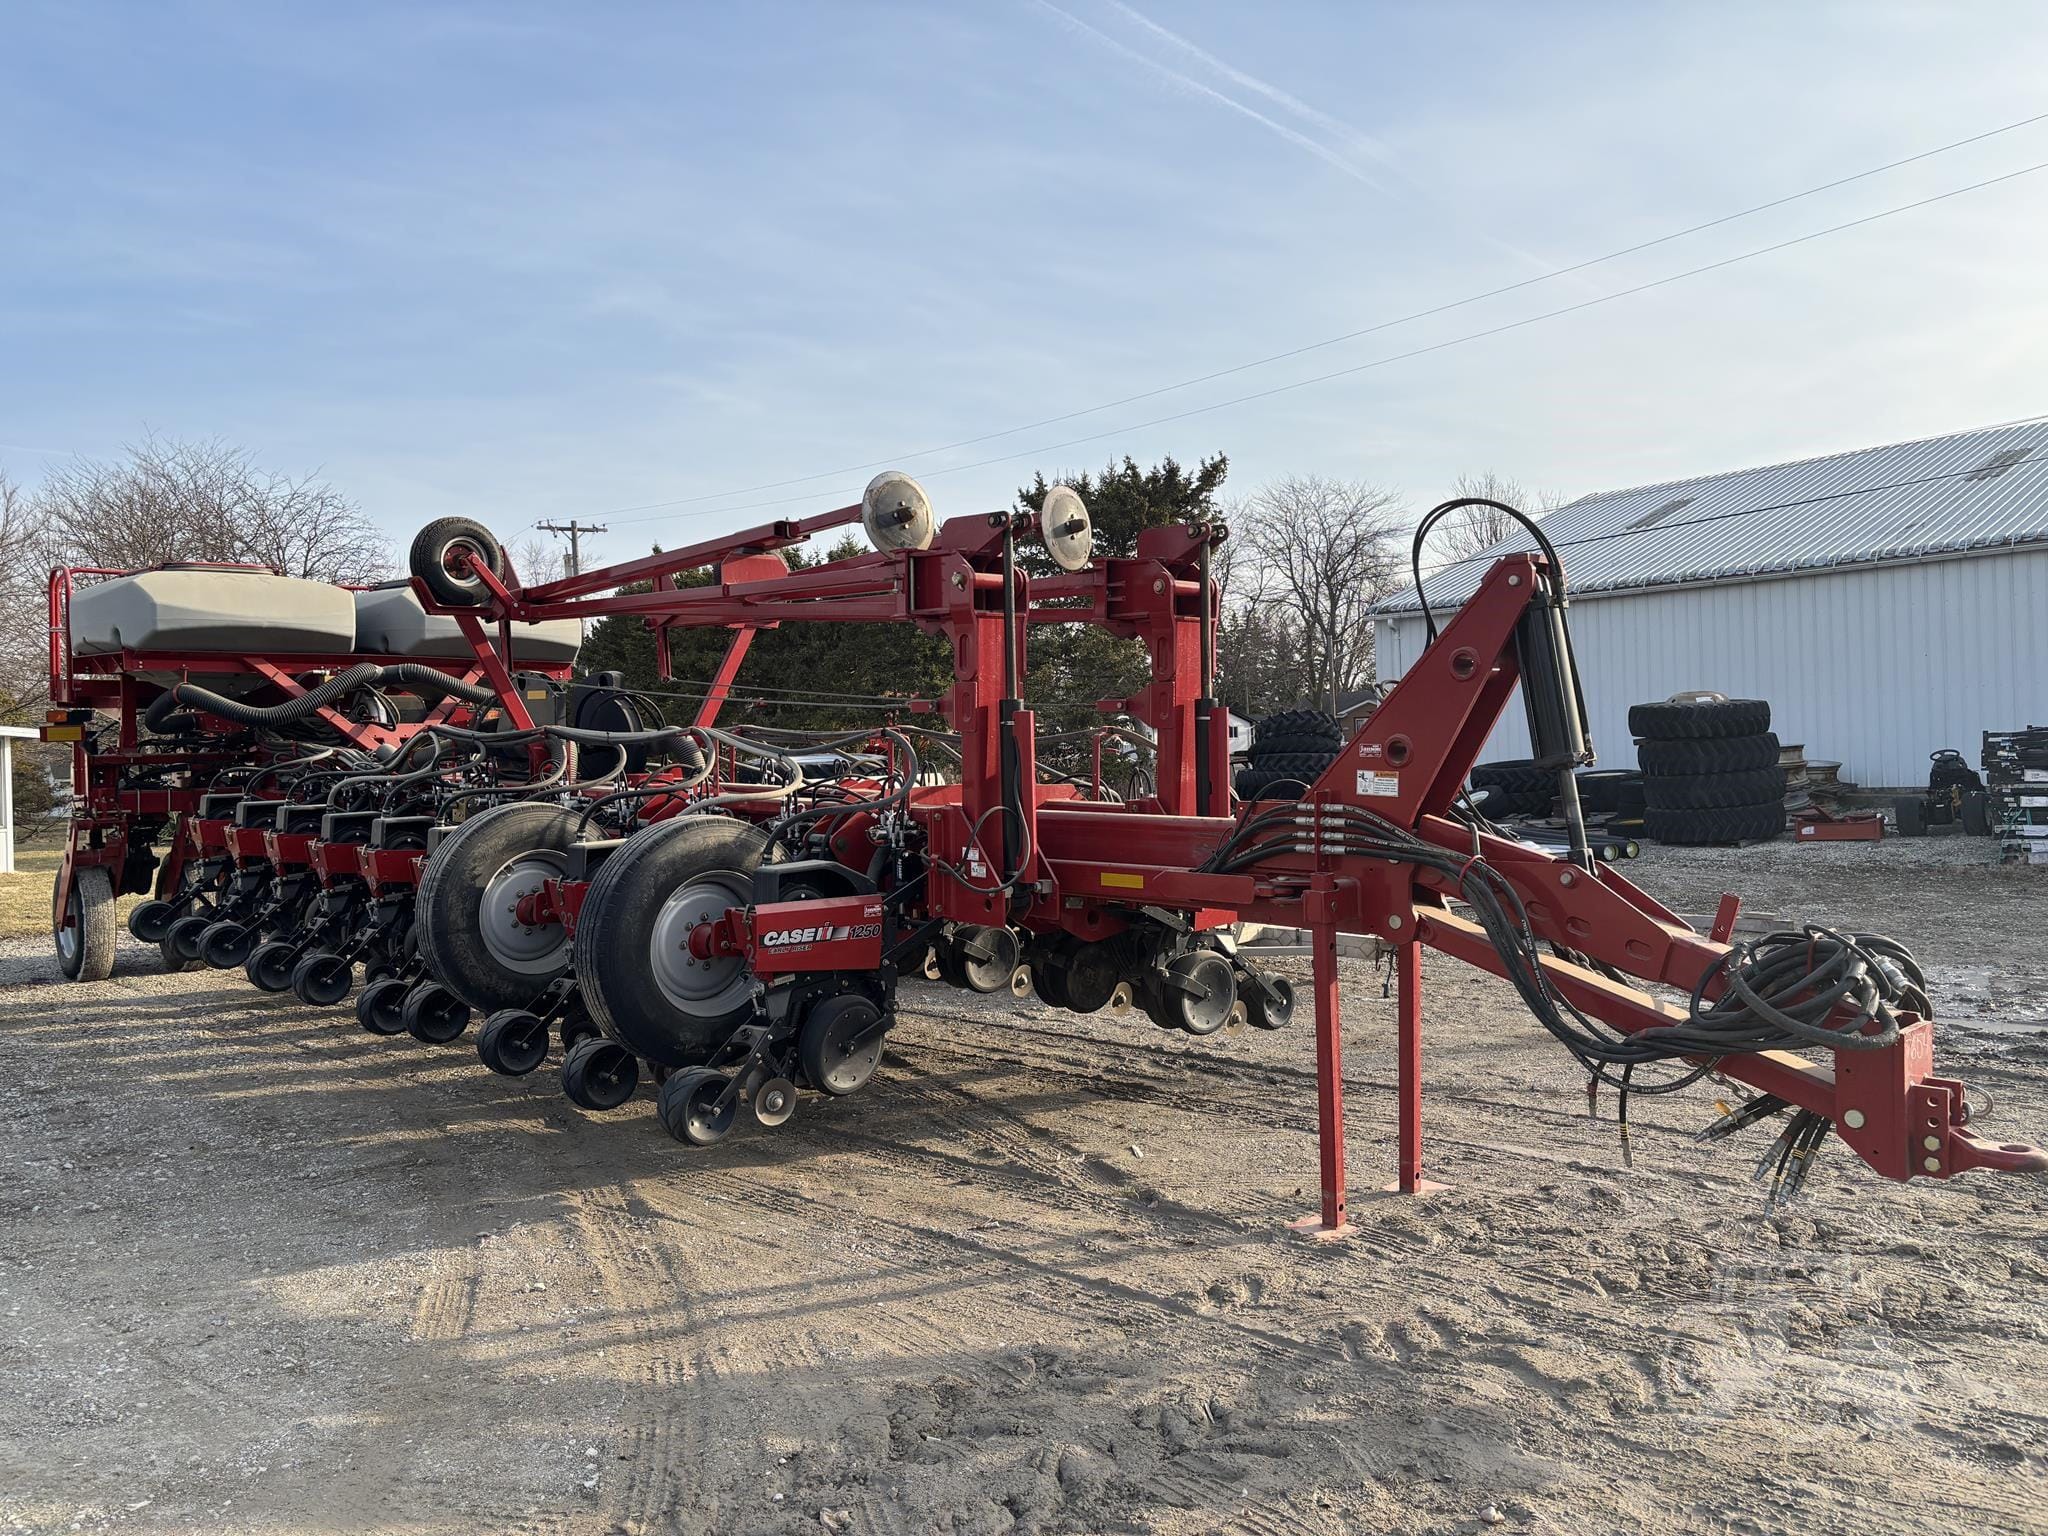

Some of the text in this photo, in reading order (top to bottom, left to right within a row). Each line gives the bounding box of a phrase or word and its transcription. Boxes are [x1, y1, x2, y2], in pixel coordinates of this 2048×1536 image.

[763, 928, 816, 946] CASE
[849, 924, 881, 939] 1250
[768, 944, 813, 955] EARLY RISER
